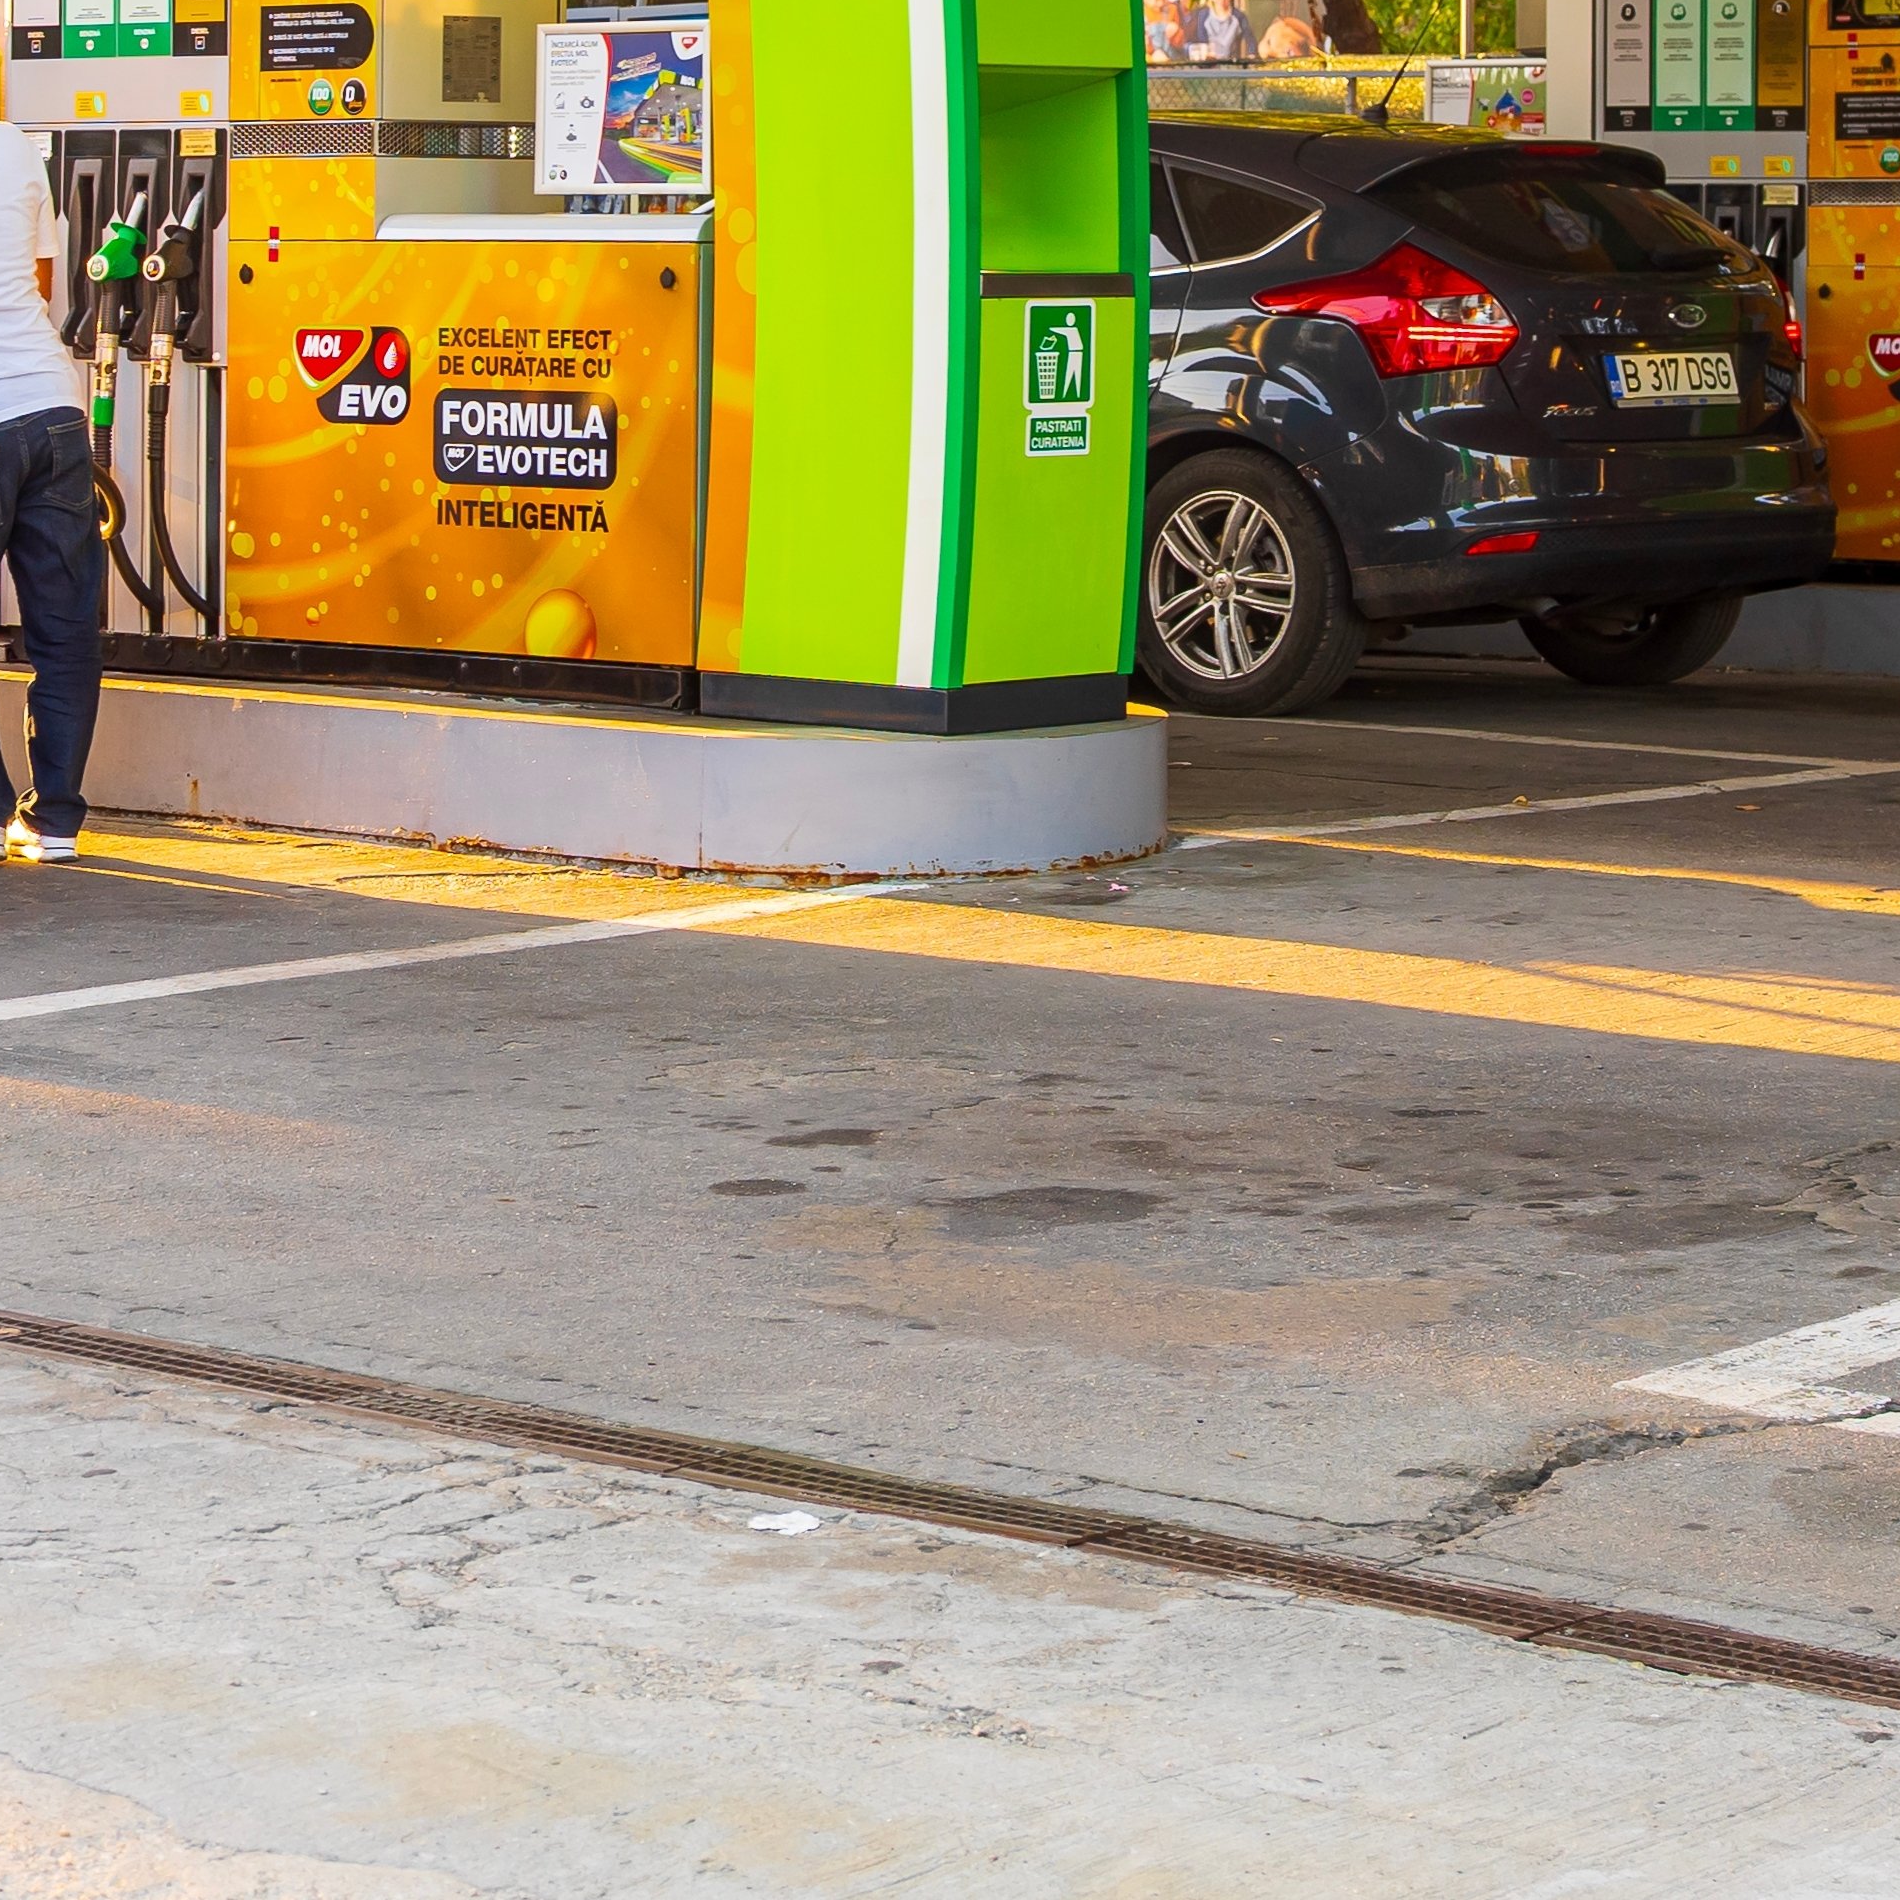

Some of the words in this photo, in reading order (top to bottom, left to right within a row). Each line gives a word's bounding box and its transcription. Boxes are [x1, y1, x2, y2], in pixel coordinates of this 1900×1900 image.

[312, 87, 329, 101] 100
[301, 334, 342, 360] MOL
[438, 327, 541, 350] EXCELENT
[547, 329, 612, 350] EFECT
[438, 355, 467, 376] DE
[471, 351, 576, 383] CURĂȚARE
[582, 358, 612, 379] CU
[1622, 359, 1641, 393] B
[1647, 357, 1679, 392] 317
[1684, 356, 1732, 391] DSG
[338, 384, 407, 418] EVO
[441, 400, 607, 440] FORMULA
[1035, 419, 1082, 434] PASTRATI
[1031, 436, 1085, 449] CURATENIA
[447, 448, 465, 460] MOL
[476, 445, 608, 478] EVOTECH
[437, 499, 610, 533] INTELIGENTĂ
